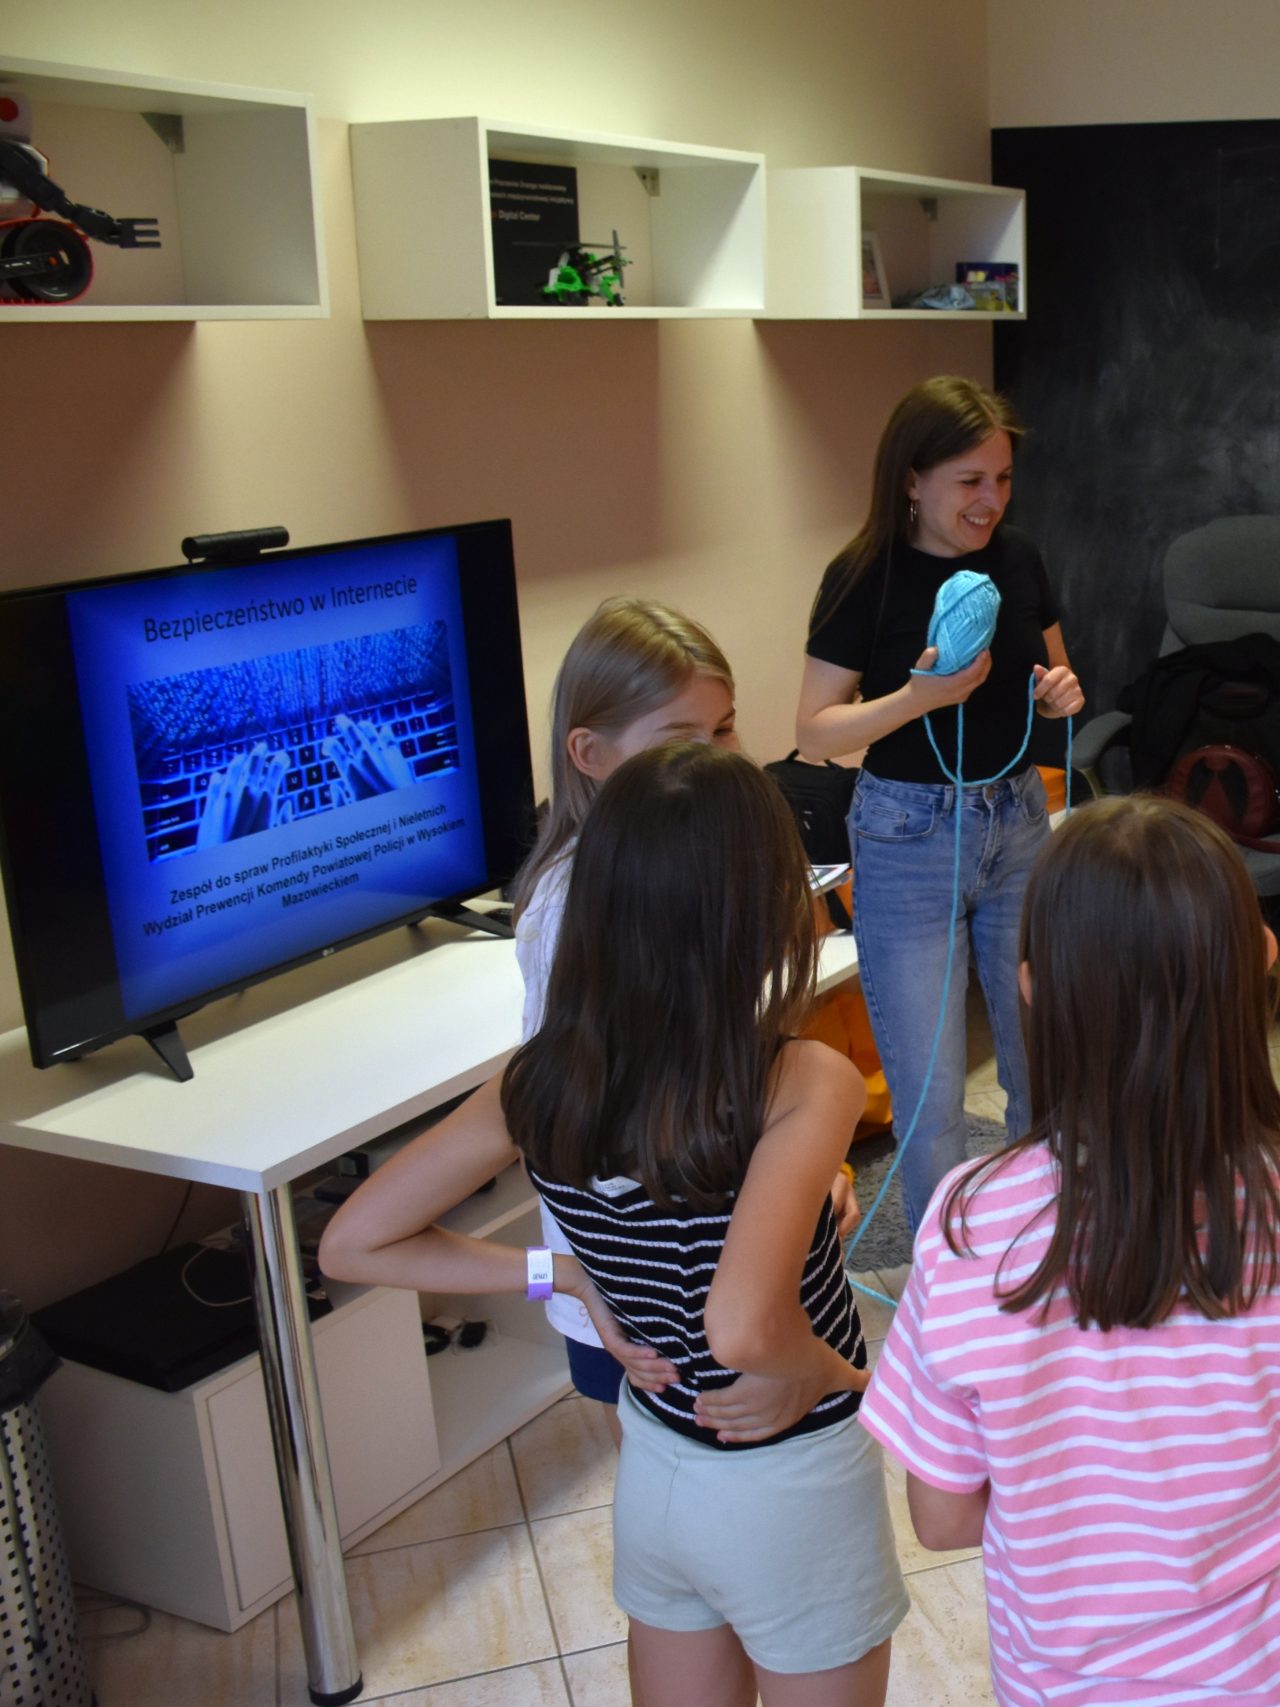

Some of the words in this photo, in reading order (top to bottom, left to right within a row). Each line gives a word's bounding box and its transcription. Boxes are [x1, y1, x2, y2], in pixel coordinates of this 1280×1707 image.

[143, 597, 305, 642] Bezpieczeństwo
[310, 594, 326, 612] w
[331, 574, 417, 608] Internecie
[142, 908, 193, 936] Wydział
[196, 890, 254, 918] Prewencji
[256, 870, 310, 897] Komendy
[312, 848, 372, 878] Powiatowej
[373, 837, 405, 858] Policji
[405, 834, 416, 845] w
[416, 817, 465, 843] Wysokiem
[170, 879, 213, 904] Zespół
[215, 875, 231, 889] do
[234, 863, 269, 884] spraw
[271, 840, 333, 870] Profilaktyki
[335, 820, 392, 849] Społecznej
[398, 803, 447, 828] Nieletnich
[282, 871, 360, 908] Mazowieckiem
